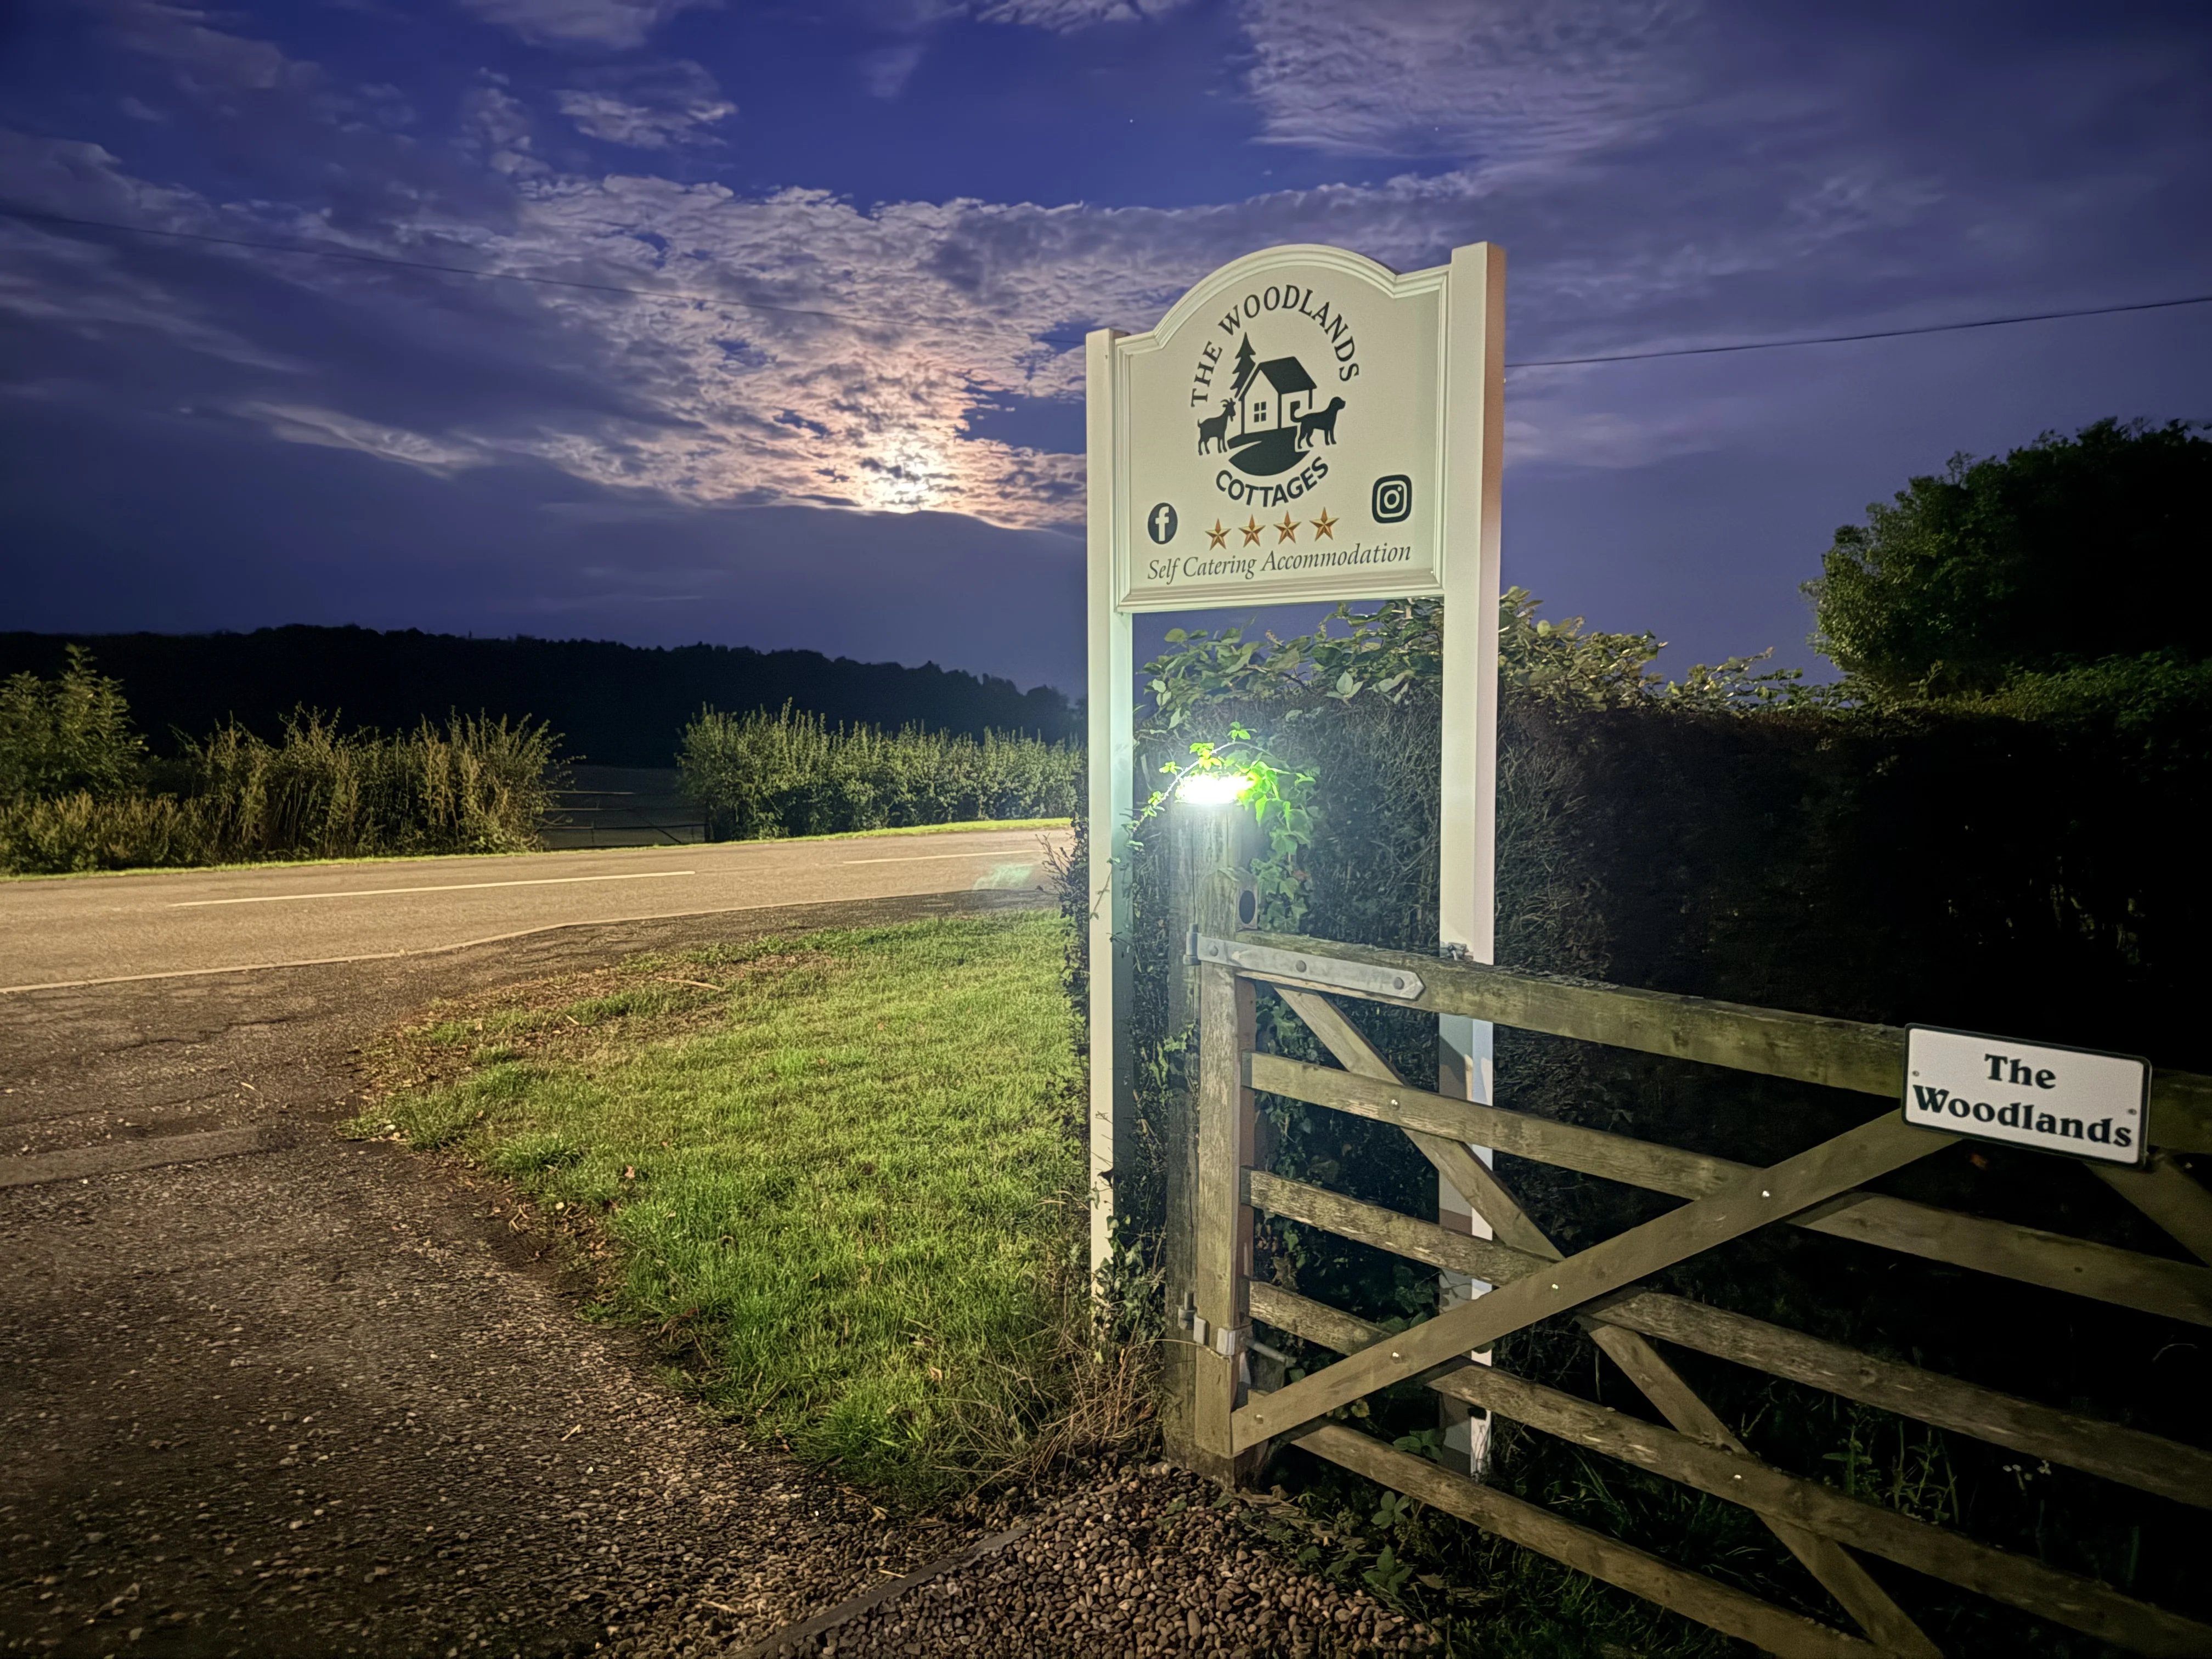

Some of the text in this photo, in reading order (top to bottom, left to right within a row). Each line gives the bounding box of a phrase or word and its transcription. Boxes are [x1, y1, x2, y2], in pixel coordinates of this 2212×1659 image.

[1190, 284, 1360, 408] THE WOODLANDS
[1215, 456, 1329, 507] COTTAGES
[1147, 543, 1412, 585] Self Catering Accommodation
[1984, 1053, 2056, 1090] The
[1912, 1084, 2132, 1148] Woodlands
